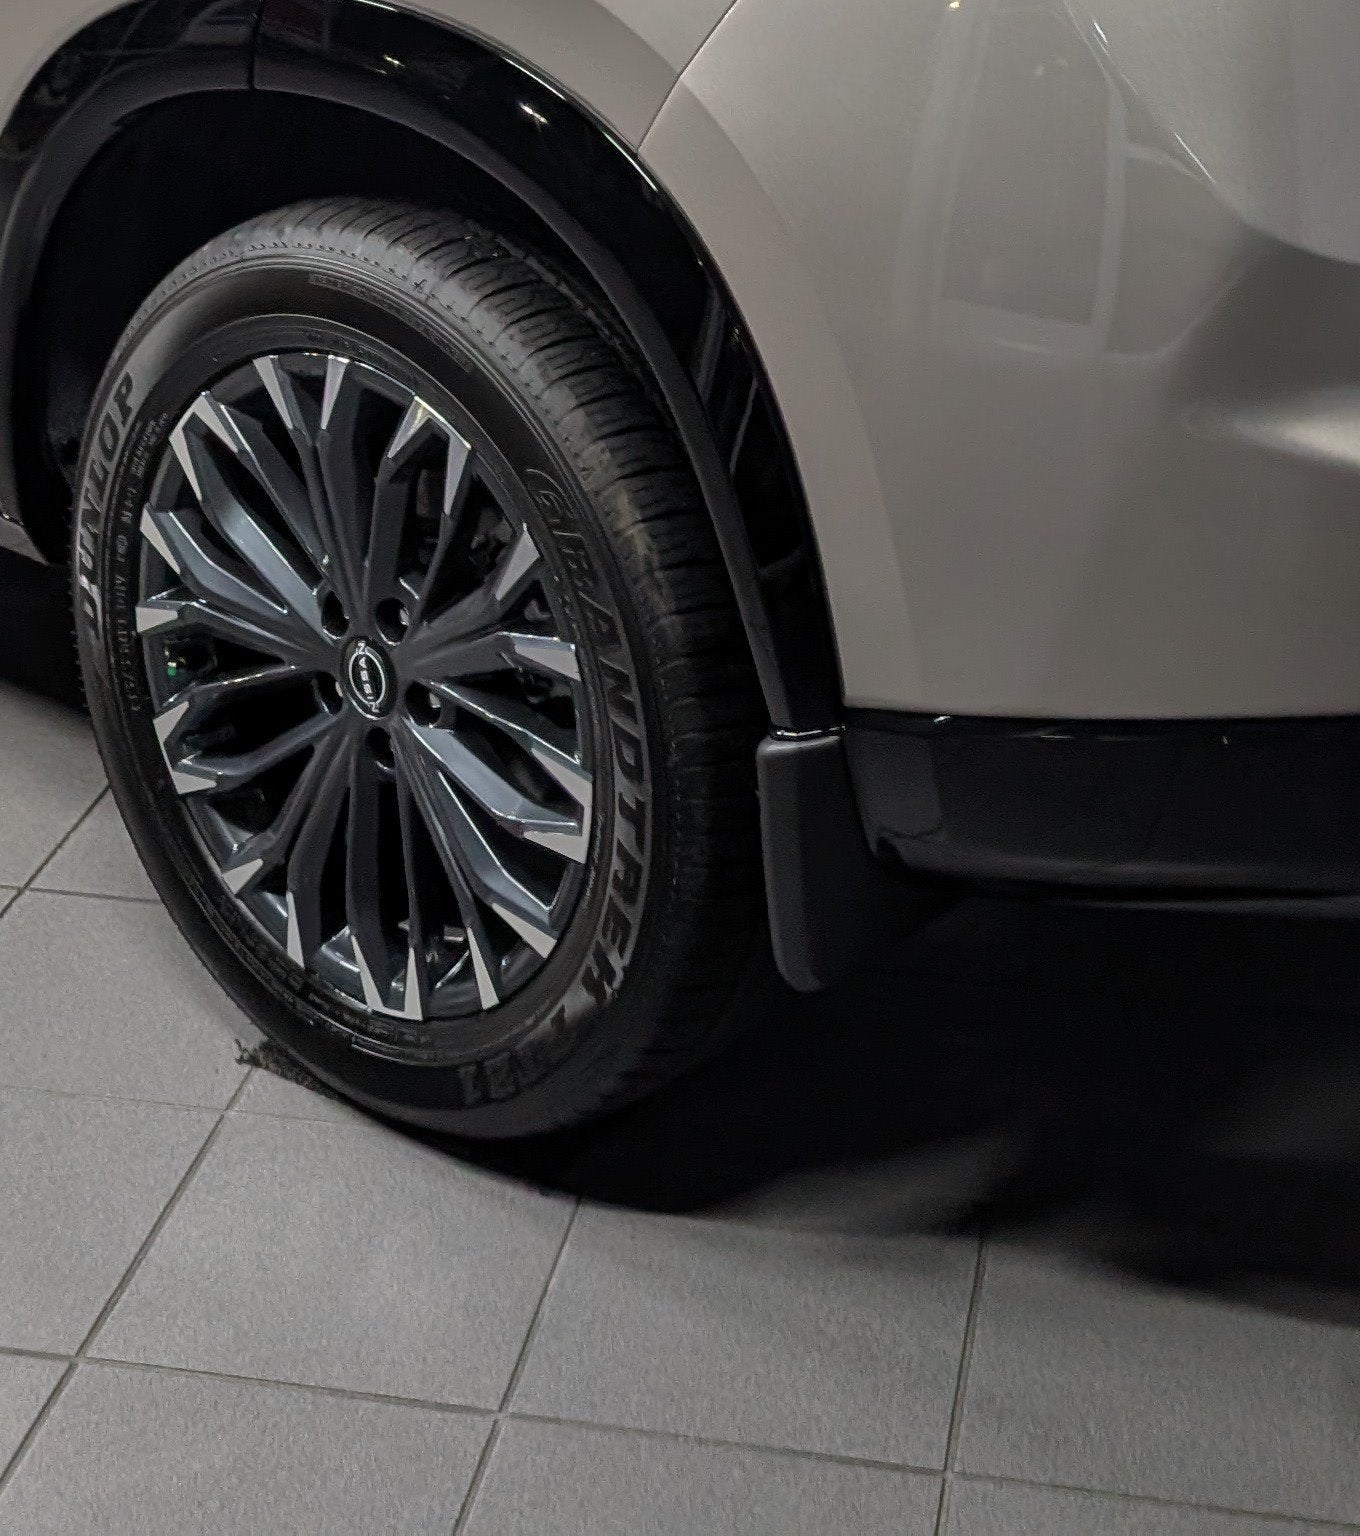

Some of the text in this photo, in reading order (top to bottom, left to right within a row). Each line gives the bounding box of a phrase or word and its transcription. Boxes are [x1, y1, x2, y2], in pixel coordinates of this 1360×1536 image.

[75, 370, 135, 644] DUNLOP
[355, 640, 380, 713] NISSAN
[526, 464, 646, 1004] GRANDTREK
